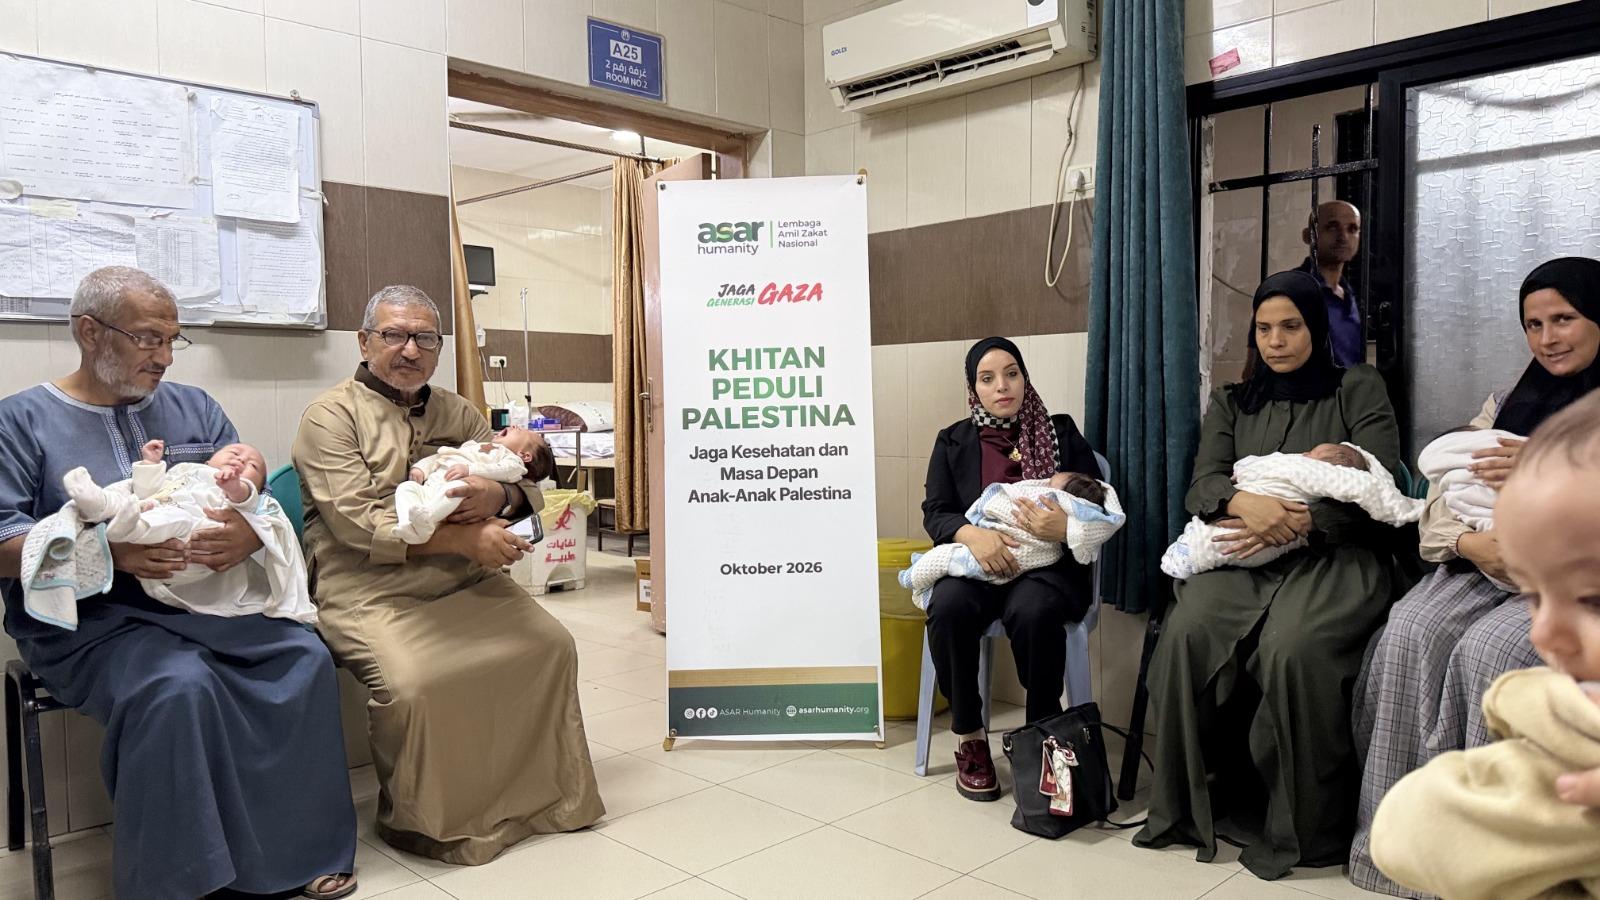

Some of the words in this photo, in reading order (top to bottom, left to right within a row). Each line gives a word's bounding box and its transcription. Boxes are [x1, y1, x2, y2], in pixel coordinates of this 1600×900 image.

[612, 43, 639, 60] A25
[605, 60, 611, 69] 2
[612, 63, 627, 75] رقم
[605, 72, 630, 85] ROOM
[629, 66, 647, 79] غرفة
[778, 220, 821, 229] Lembaga
[698, 221, 765, 243] asar
[778, 229, 800, 238] Amil
[801, 229, 828, 238] Zakat
[697, 243, 759, 256] humanity
[778, 239, 818, 248] Nasional
[718, 284, 755, 298] JAGA
[758, 282, 823, 305] GAZA
[706, 298, 755, 307] GENERASI
[709, 346, 825, 371] KHITAN
[713, 376, 823, 400] PEDULI
[682, 404, 856, 430] PALESTINA
[689, 445, 728, 463] Jaga
[731, 444, 816, 459] Kesehatan
[818, 443, 849, 457] dan
[720, 467, 764, 481] Masa
[767, 466, 819, 483] Depan
[688, 488, 777, 503] Anak-Anak
[779, 486, 852, 501] Palestina
[720, 563, 783, 575] Oktober
[786, 562, 823, 574] 2026
[720, 707, 741, 716] ASAR
[742, 707, 781, 716] Humanity
[798, 704, 870, 715] asarhumanity.org
